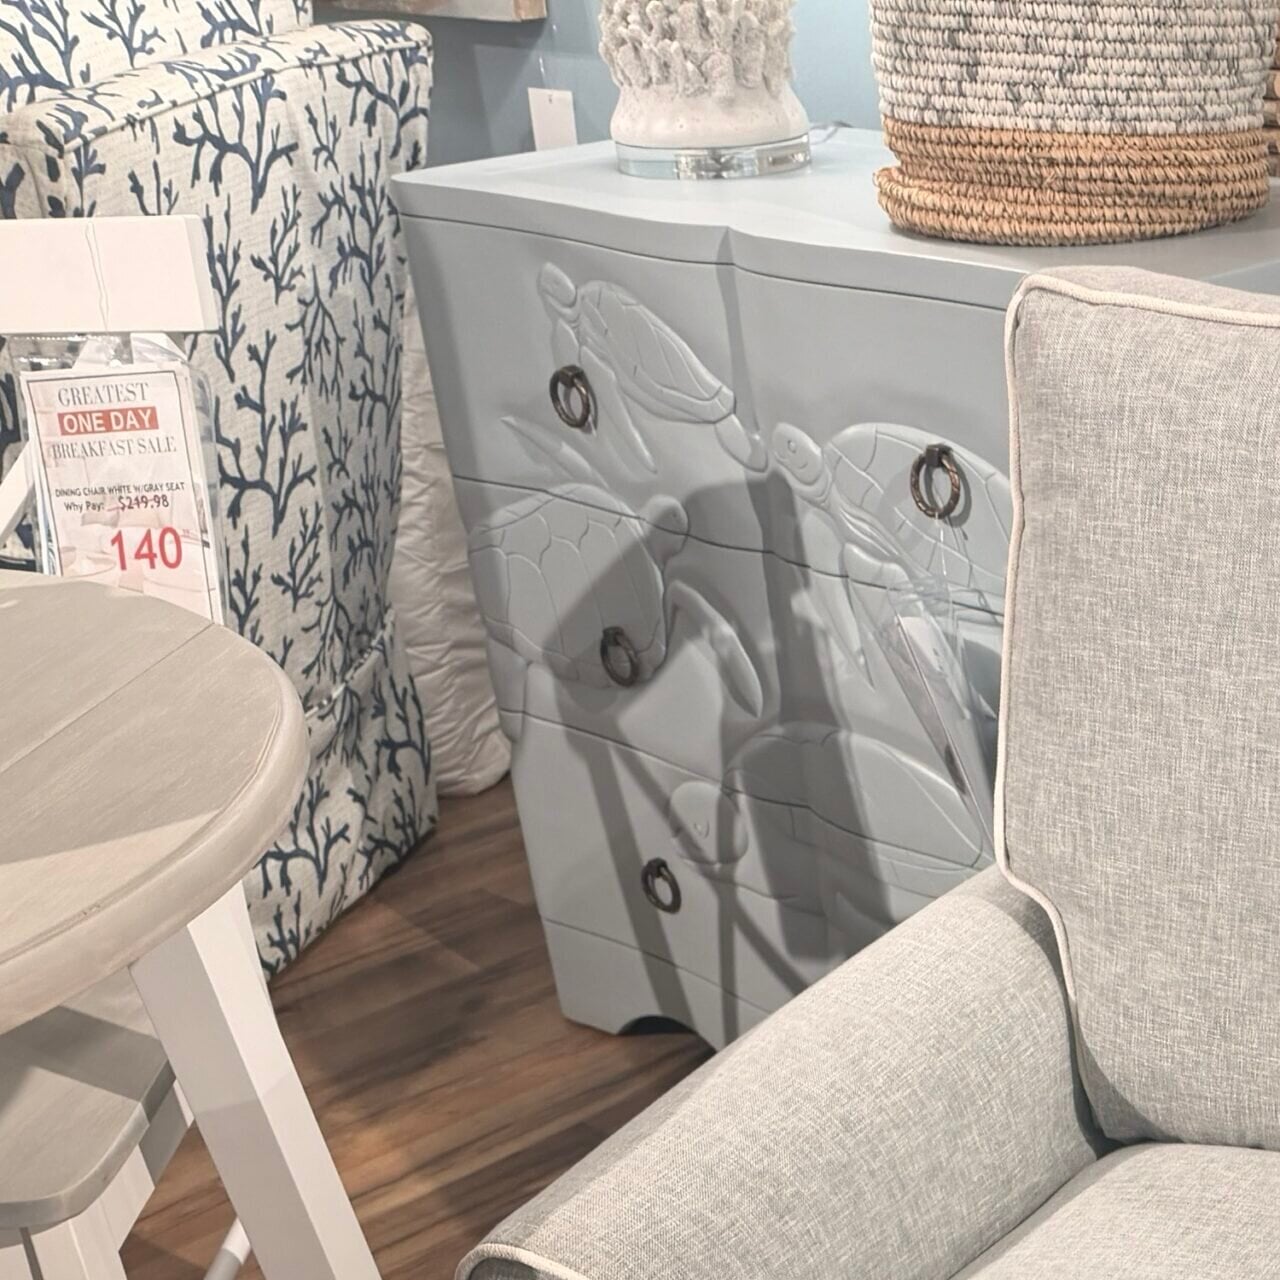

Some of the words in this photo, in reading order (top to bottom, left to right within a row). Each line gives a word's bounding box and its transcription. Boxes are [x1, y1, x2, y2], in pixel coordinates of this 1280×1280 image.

[58, 382, 149, 407] GREATEST
[63, 412, 106, 434] ONE
[110, 408, 152, 430] DAY
[52, 438, 134, 460] BREAKFAST
[138, 435, 177, 455] SALE
[55, 488, 81, 498] DINING
[83, 486, 106, 497] CHAIR
[108, 485, 132, 495] WHITE
[166, 481, 185, 492] SEAT
[64, 501, 83, 513] Why
[85, 501, 105, 513] Pay:
[111, 526, 183, 571] 140
